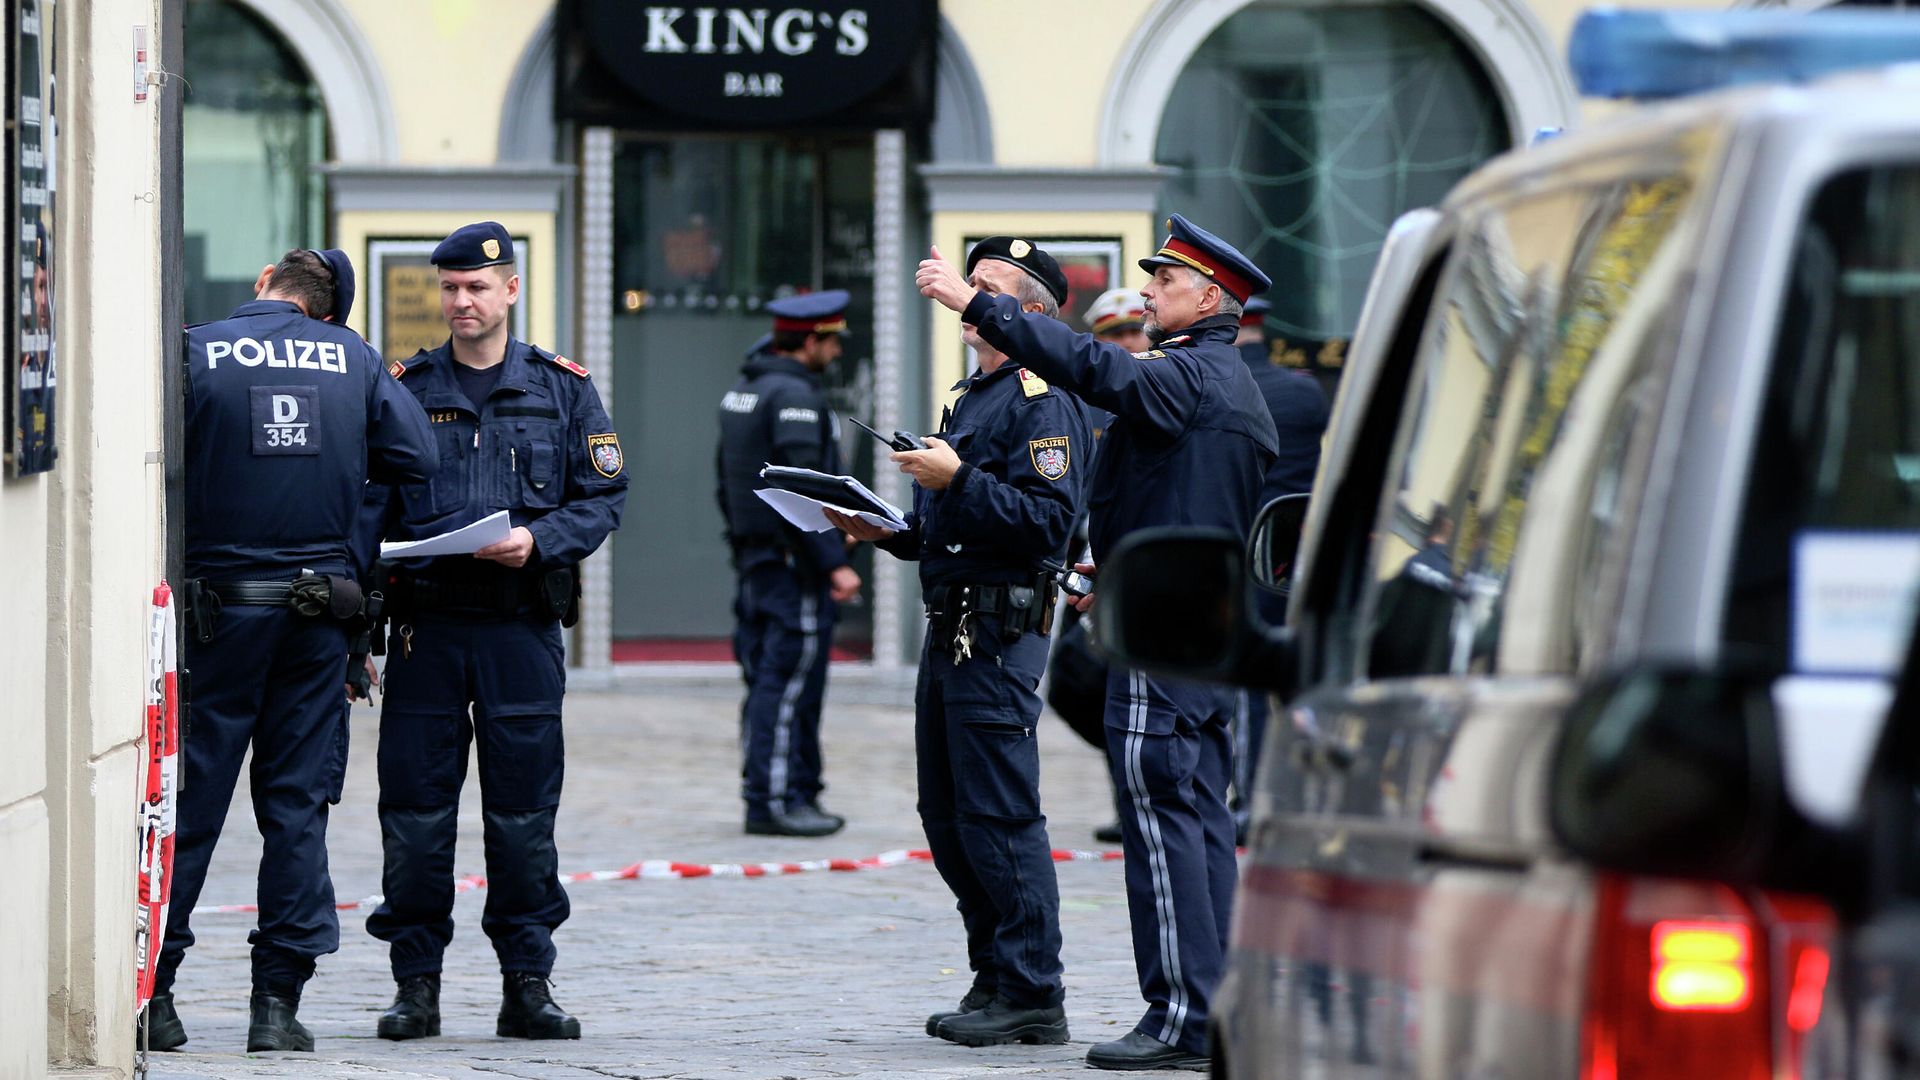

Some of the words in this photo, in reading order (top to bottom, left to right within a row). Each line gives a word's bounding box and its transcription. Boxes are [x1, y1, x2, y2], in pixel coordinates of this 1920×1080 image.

[723, 71, 783, 97] BAR
[206, 337, 347, 374] POLIZEI
[272, 394, 299, 423] D
[431, 411, 457, 423] IZEI
[266, 428, 307, 447] 354
[1033, 439, 1066, 449] POLIZEI
